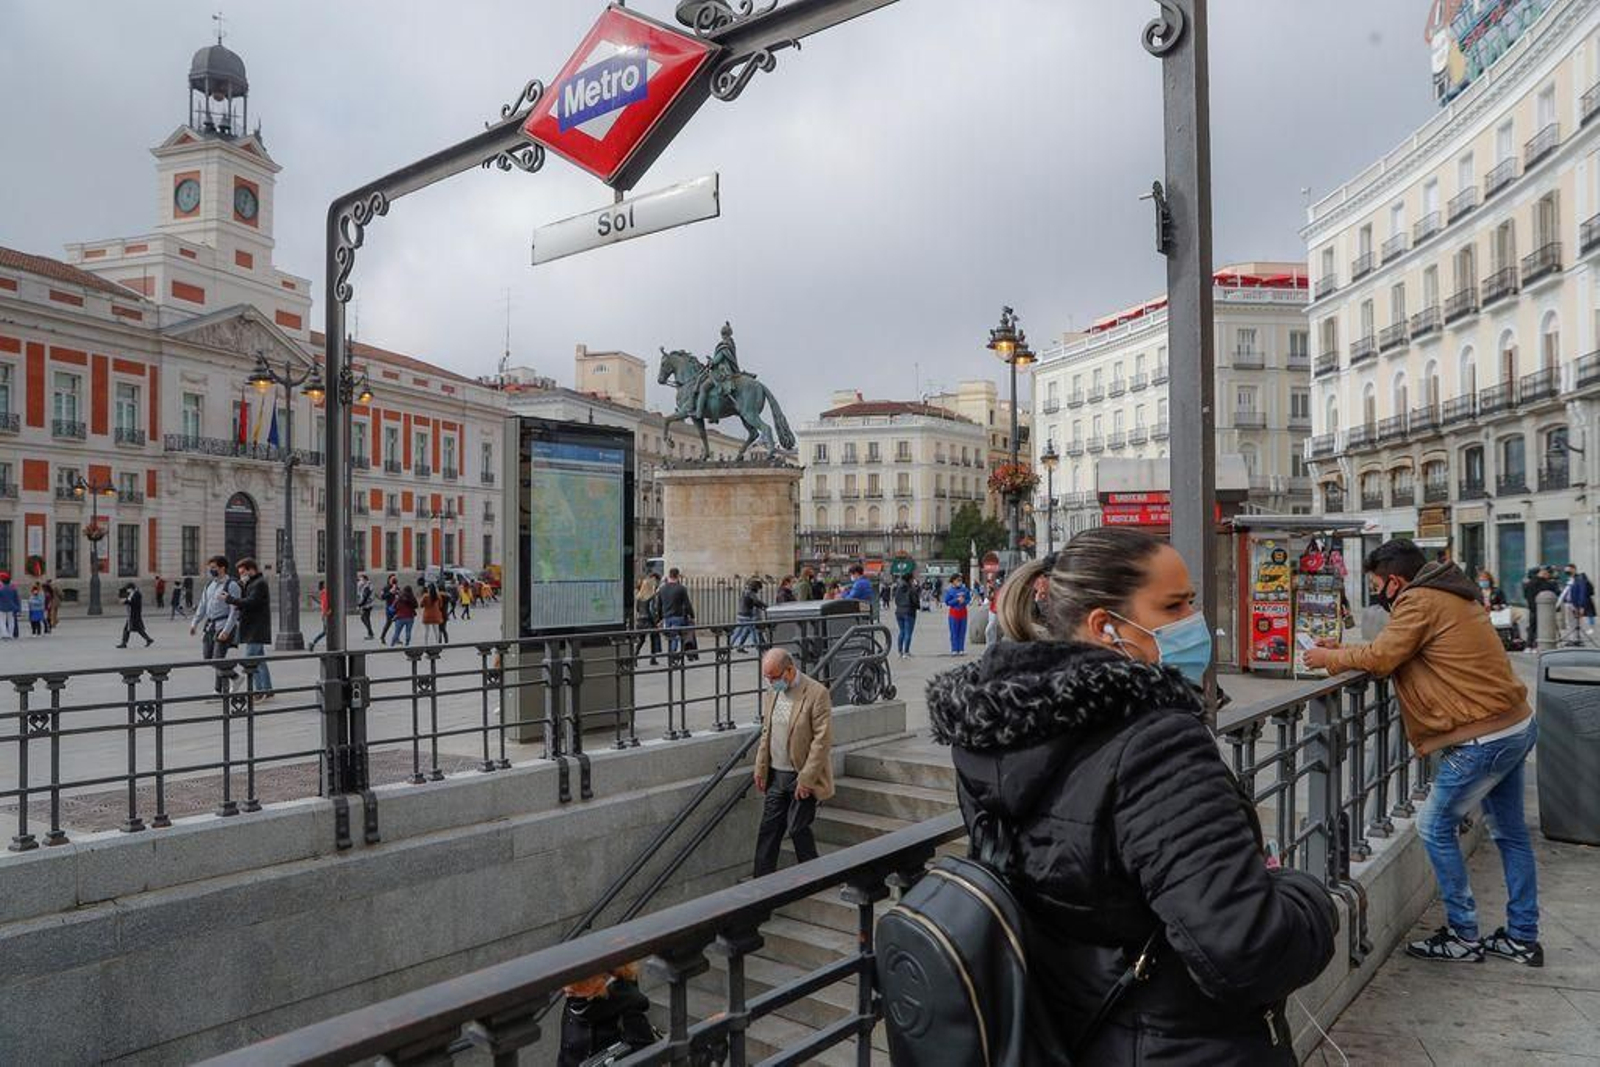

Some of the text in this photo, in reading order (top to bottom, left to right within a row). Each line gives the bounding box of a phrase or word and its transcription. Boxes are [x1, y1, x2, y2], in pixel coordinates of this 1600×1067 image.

[564, 64, 640, 118] Metro
[597, 204, 634, 236] Sol
[1253, 605, 1287, 613] MADRID
